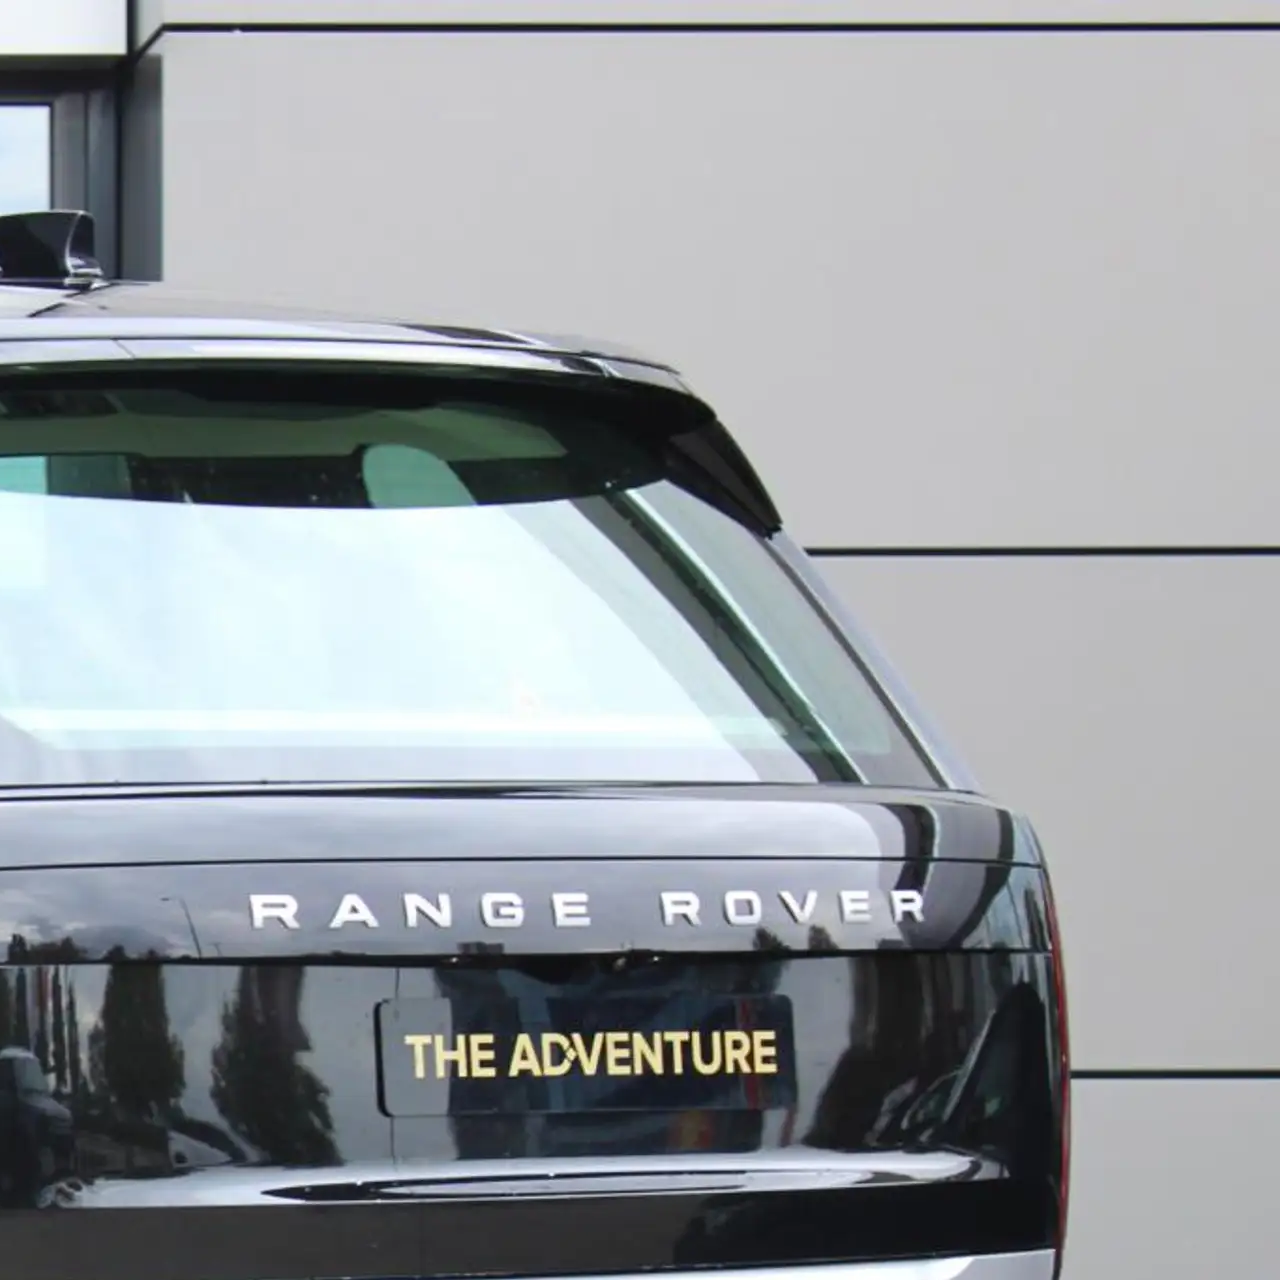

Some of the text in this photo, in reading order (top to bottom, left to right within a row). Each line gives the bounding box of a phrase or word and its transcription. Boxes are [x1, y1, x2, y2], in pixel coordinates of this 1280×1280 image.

[249, 889, 926, 930] RANGE ROVER
[404, 1030, 778, 1079] THE ADVENTURE
